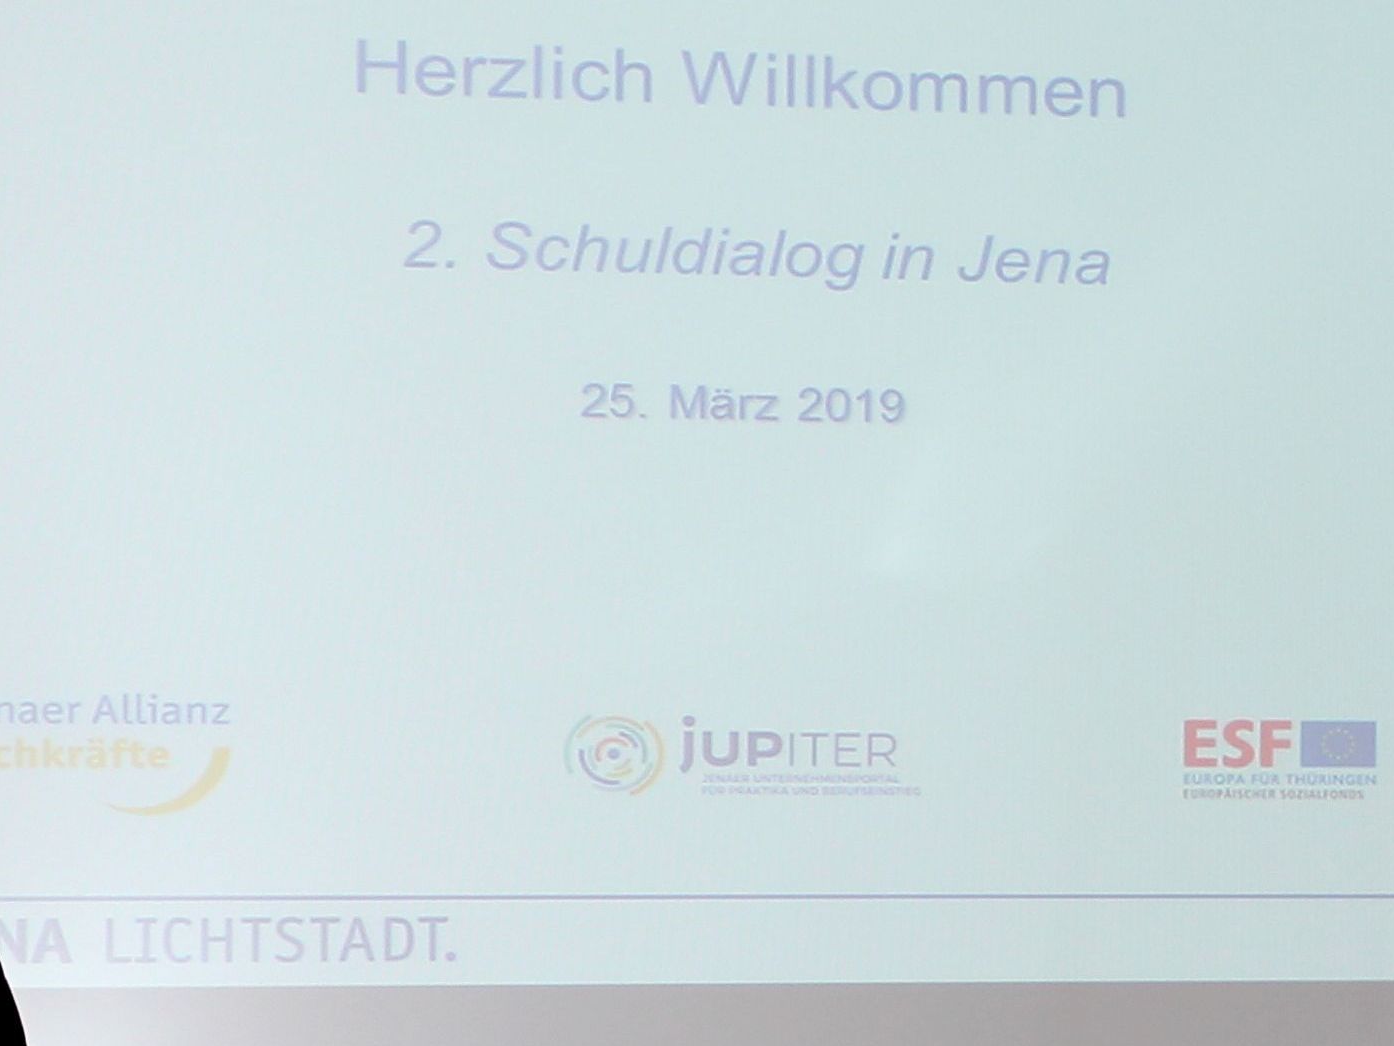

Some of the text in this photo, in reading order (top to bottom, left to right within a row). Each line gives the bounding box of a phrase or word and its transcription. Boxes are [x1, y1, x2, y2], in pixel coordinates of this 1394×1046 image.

[354, 39, 1128, 118] Herzlich Willkommen
[403, 220, 1112, 291] 2. Schuldialog in Jena
[580, 384, 906, 424] 25. März 2019
[92, 693, 231, 725] Allianz
[1183, 719, 1293, 768] ESF
[1183, 772, 1377, 786] EUROPA FÜR THÜRINGEN
[105, 916, 457, 964] LICHTSTADT.
